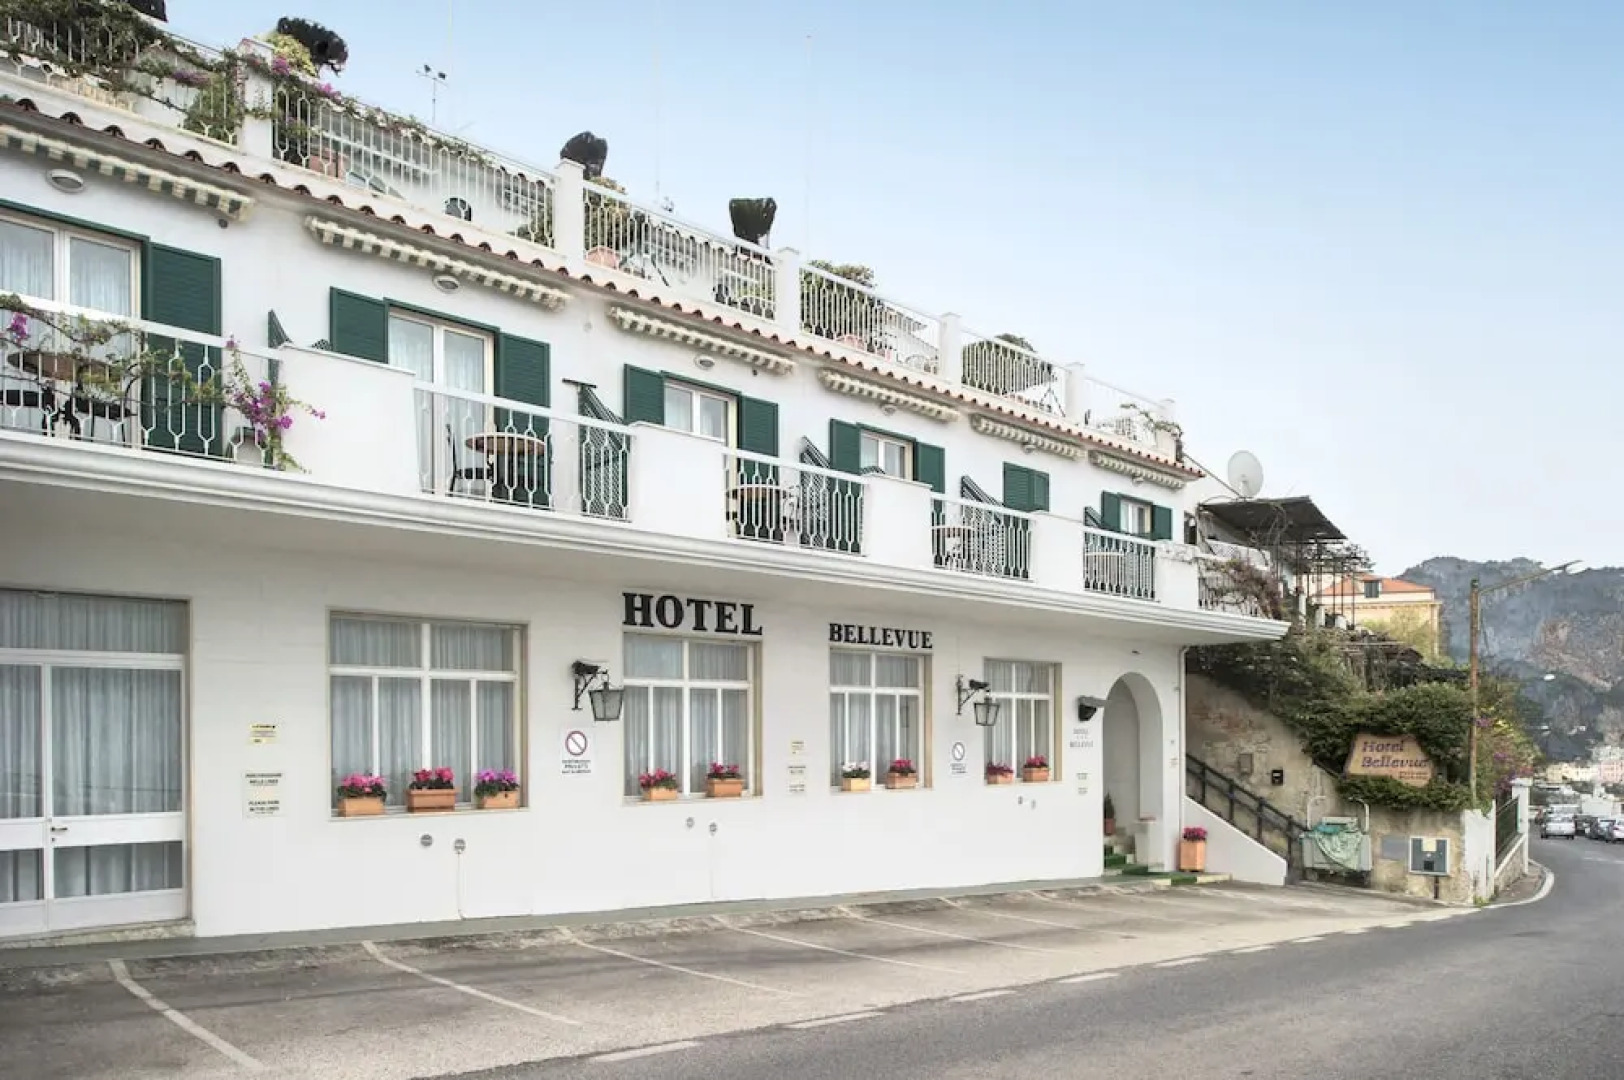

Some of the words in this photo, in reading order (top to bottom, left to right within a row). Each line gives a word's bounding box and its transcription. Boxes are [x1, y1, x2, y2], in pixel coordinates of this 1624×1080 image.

[622, 592, 763, 636] HOTEL
[829, 622, 933, 649] BELLEVUE
[1362, 740, 1404, 752] Hotel
[1361, 755, 1429, 768] Bellevue
